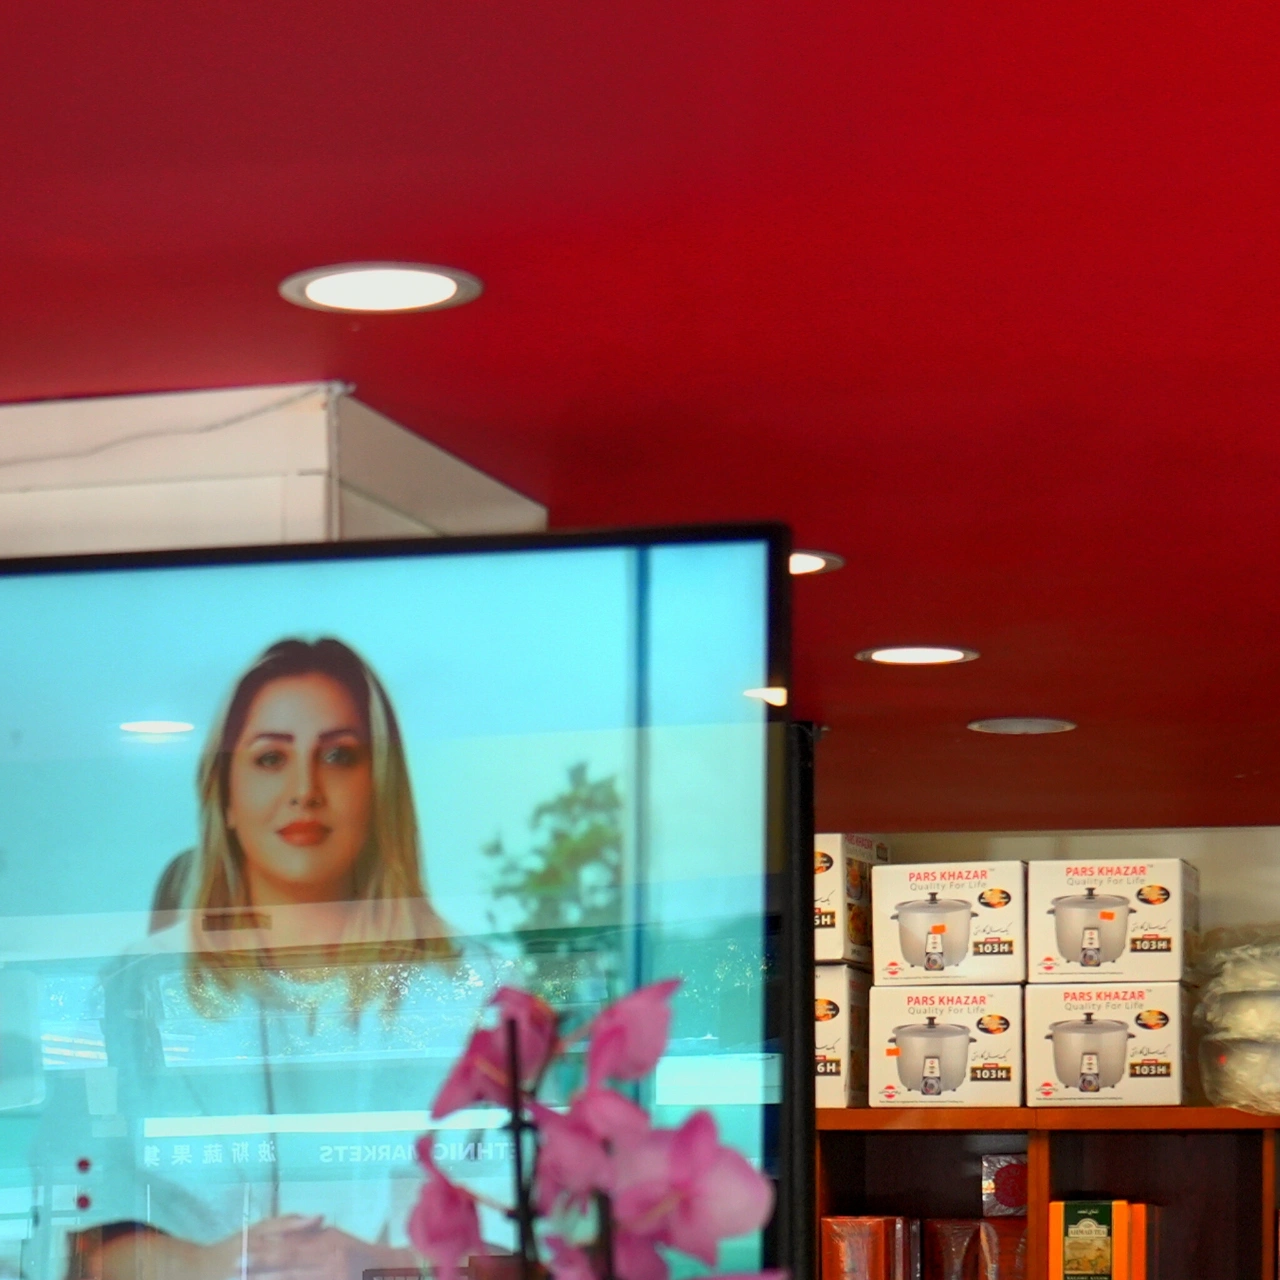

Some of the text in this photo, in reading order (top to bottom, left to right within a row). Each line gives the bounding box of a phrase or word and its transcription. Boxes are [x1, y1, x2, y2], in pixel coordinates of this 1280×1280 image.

[909, 870, 987, 881] PARS KHAZAR
[1066, 866, 1147, 876] PARS KHAZAR
[910, 882, 946, 891] Quality
[950, 881, 965, 889] For
[1066, 877, 1103, 886] Quality
[1127, 876, 1146, 884] Life
[814, 915, 831, 925] 6H
[978, 943, 1009, 953] 103H
[1136, 941, 1167, 950] 103H
[907, 996, 986, 1005] PARS KHAZAR
[1064, 991, 1145, 1001] PARS KHAZAR
[908, 1006, 945, 1015] Quality
[948, 1006, 963, 1014] For
[1064, 1002, 1101, 1011] Quality
[816, 1062, 836, 1073] 6H
[1134, 1066, 1167, 1075] 103H
[976, 1070, 1007, 1078] 103H
